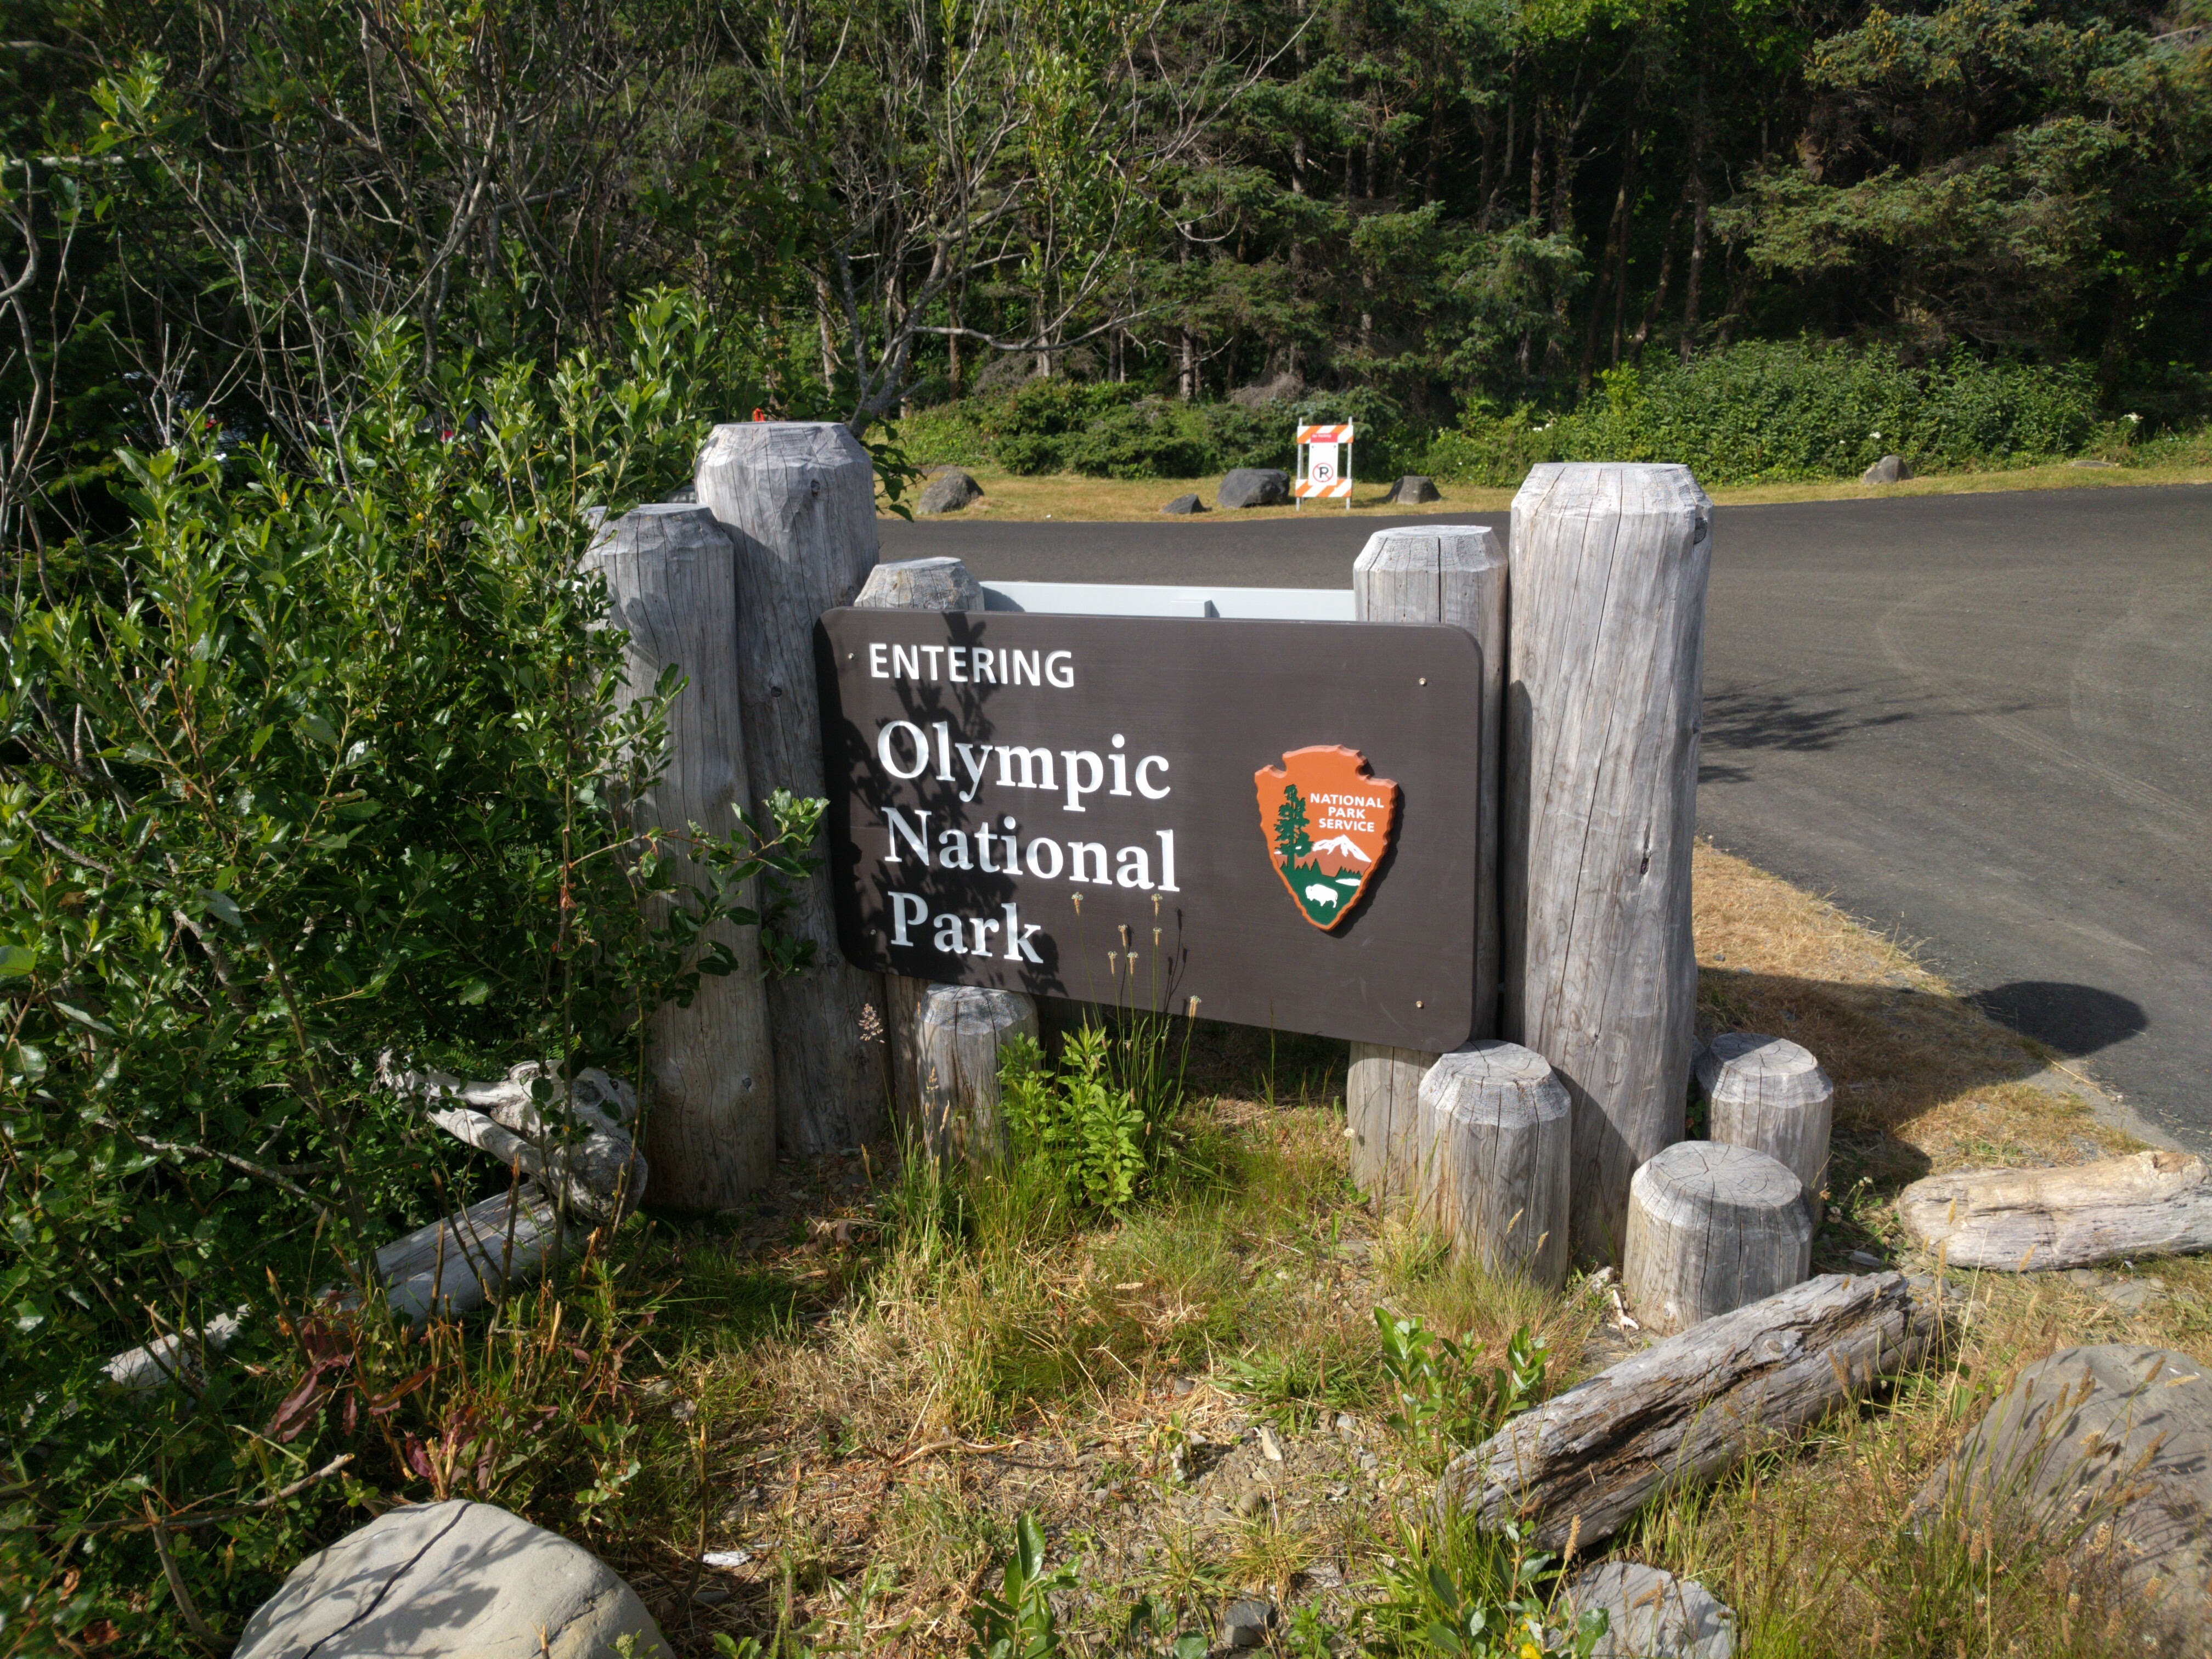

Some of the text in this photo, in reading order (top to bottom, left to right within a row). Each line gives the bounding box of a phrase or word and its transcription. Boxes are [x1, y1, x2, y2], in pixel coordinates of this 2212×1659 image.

[869, 642, 1075, 689] ENTERING
[877, 720, 1171, 812] Olympic
[1310, 793, 1384, 808] NATIONAL
[1328, 806, 1365, 819] PARK
[1318, 818, 1375, 833] SERVICE
[881, 807, 1181, 893] National
[888, 891, 1043, 964] Park
